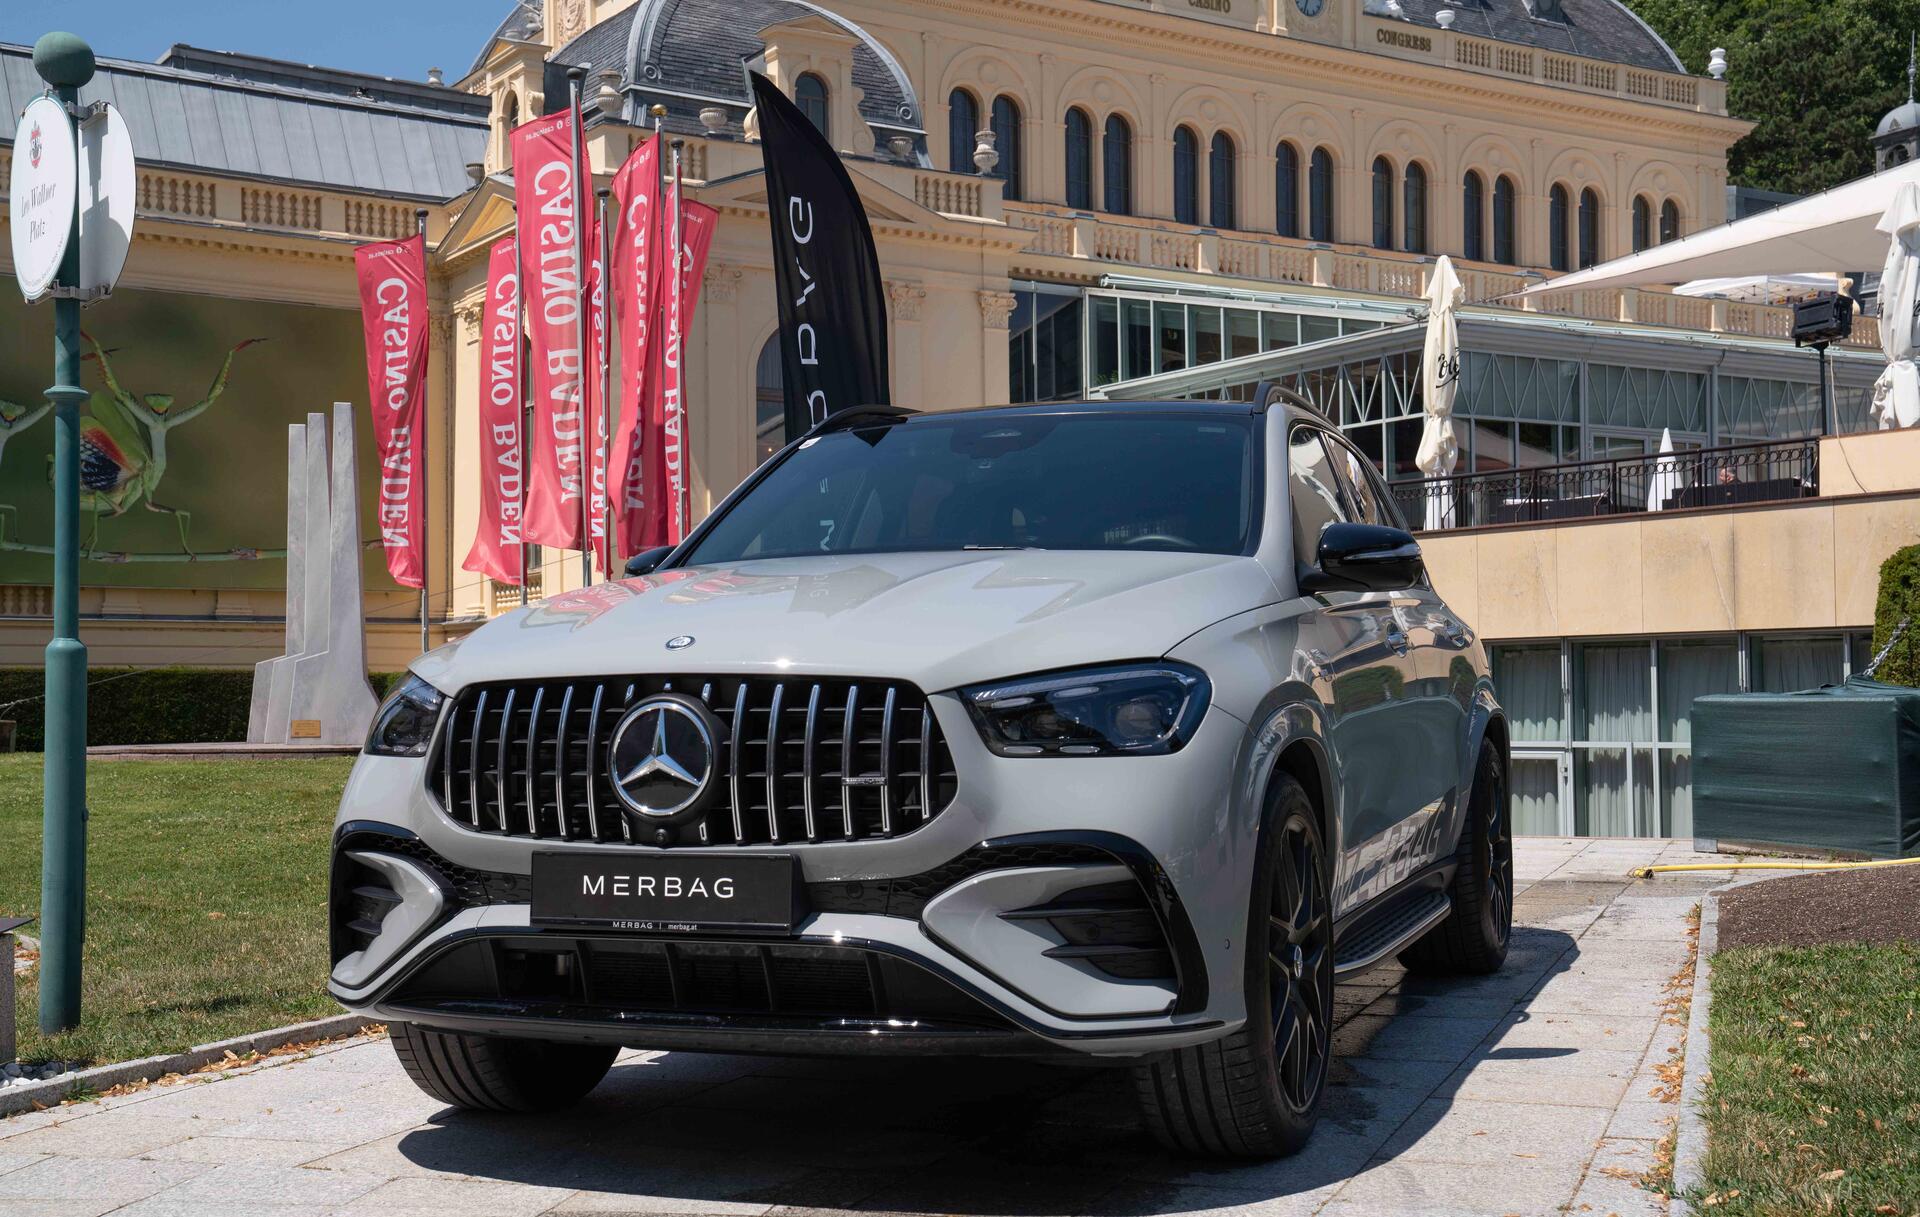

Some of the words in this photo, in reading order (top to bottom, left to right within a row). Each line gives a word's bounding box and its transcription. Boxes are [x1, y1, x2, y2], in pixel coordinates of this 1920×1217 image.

[1377, 28, 1431, 52] CONGRESS
[30, 218, 46, 243] Platz
[583, 874, 734, 899] MERBAG
[612, 921, 653, 929] MERBAG
[667, 923, 697, 931] merbag.at
